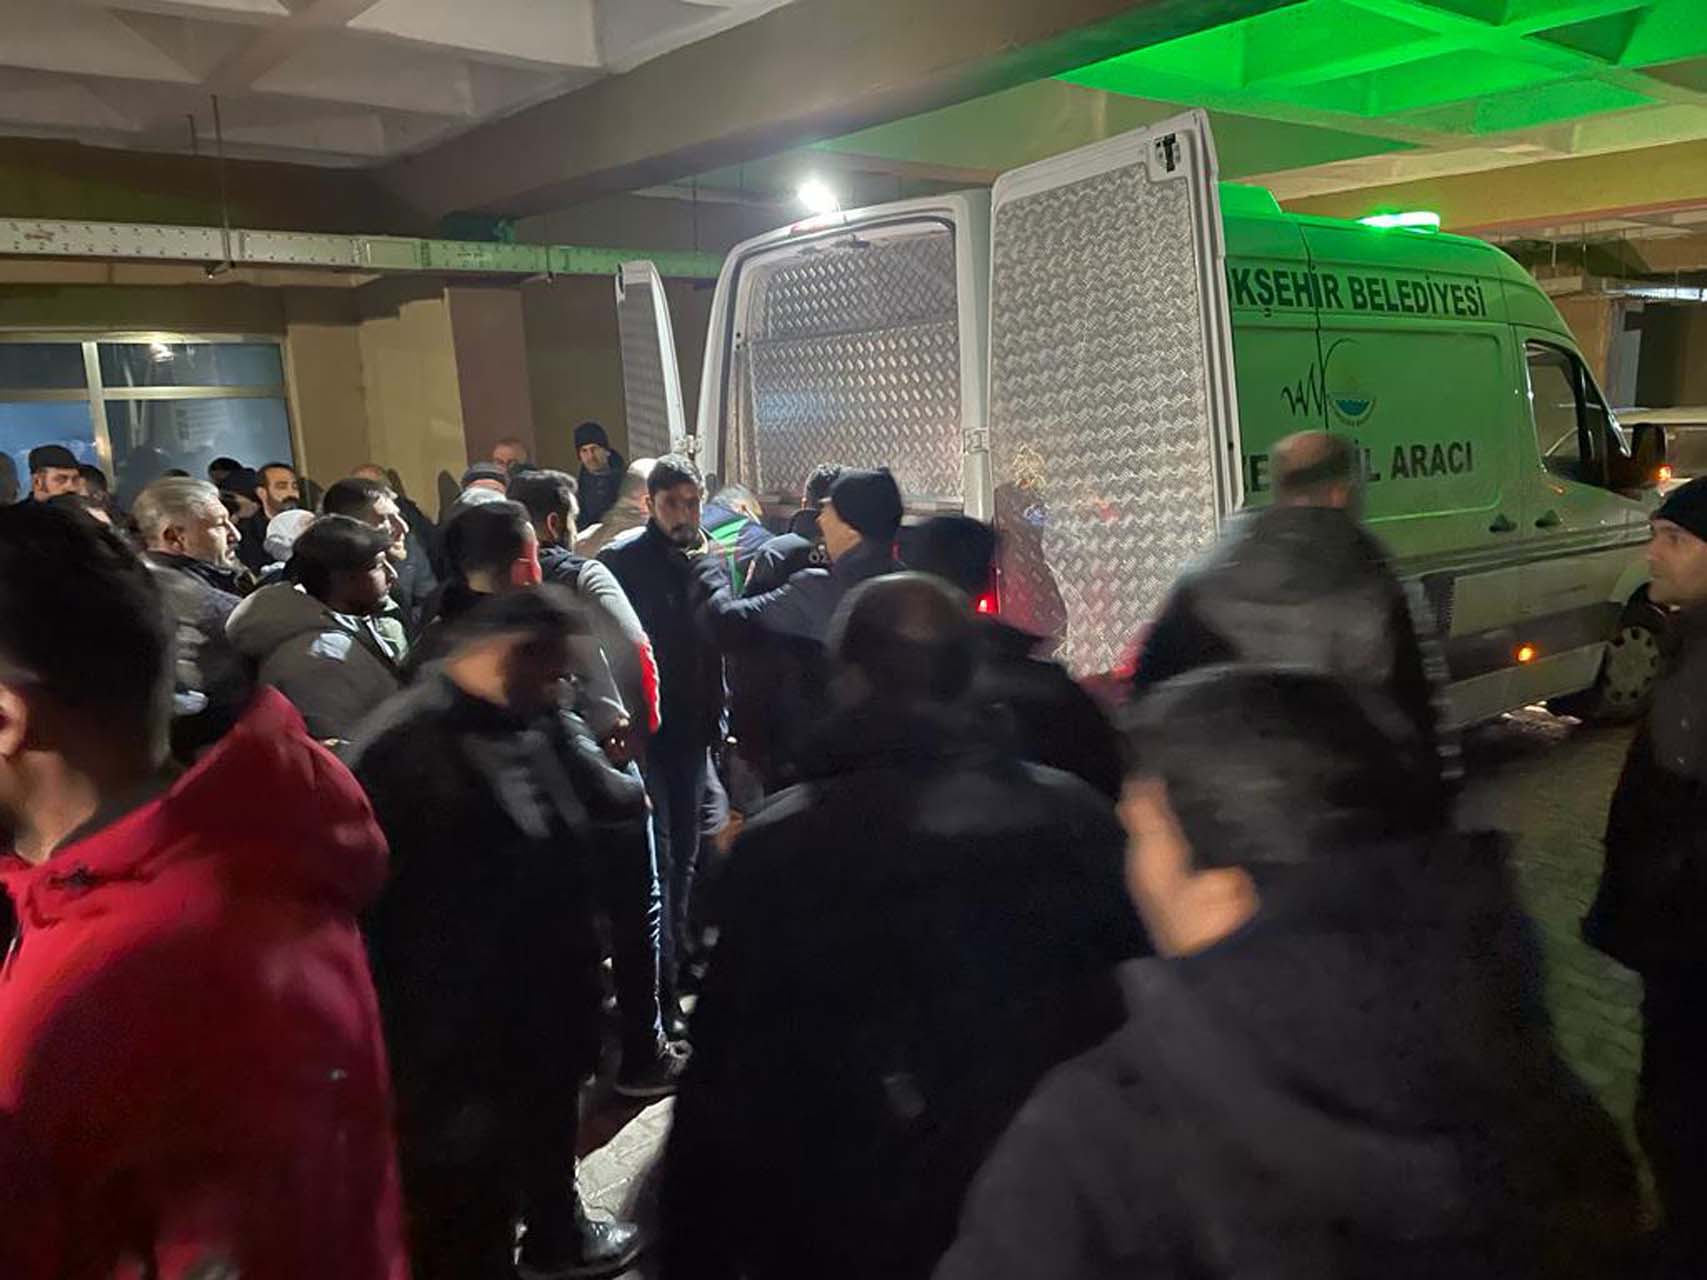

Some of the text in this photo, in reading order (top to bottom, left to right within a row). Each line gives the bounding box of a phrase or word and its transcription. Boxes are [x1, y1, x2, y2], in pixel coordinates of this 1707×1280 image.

[1227, 264, 1487, 318] KŞEHİR BELEDİYESİ
[1391, 441, 1473, 480] ARACI
